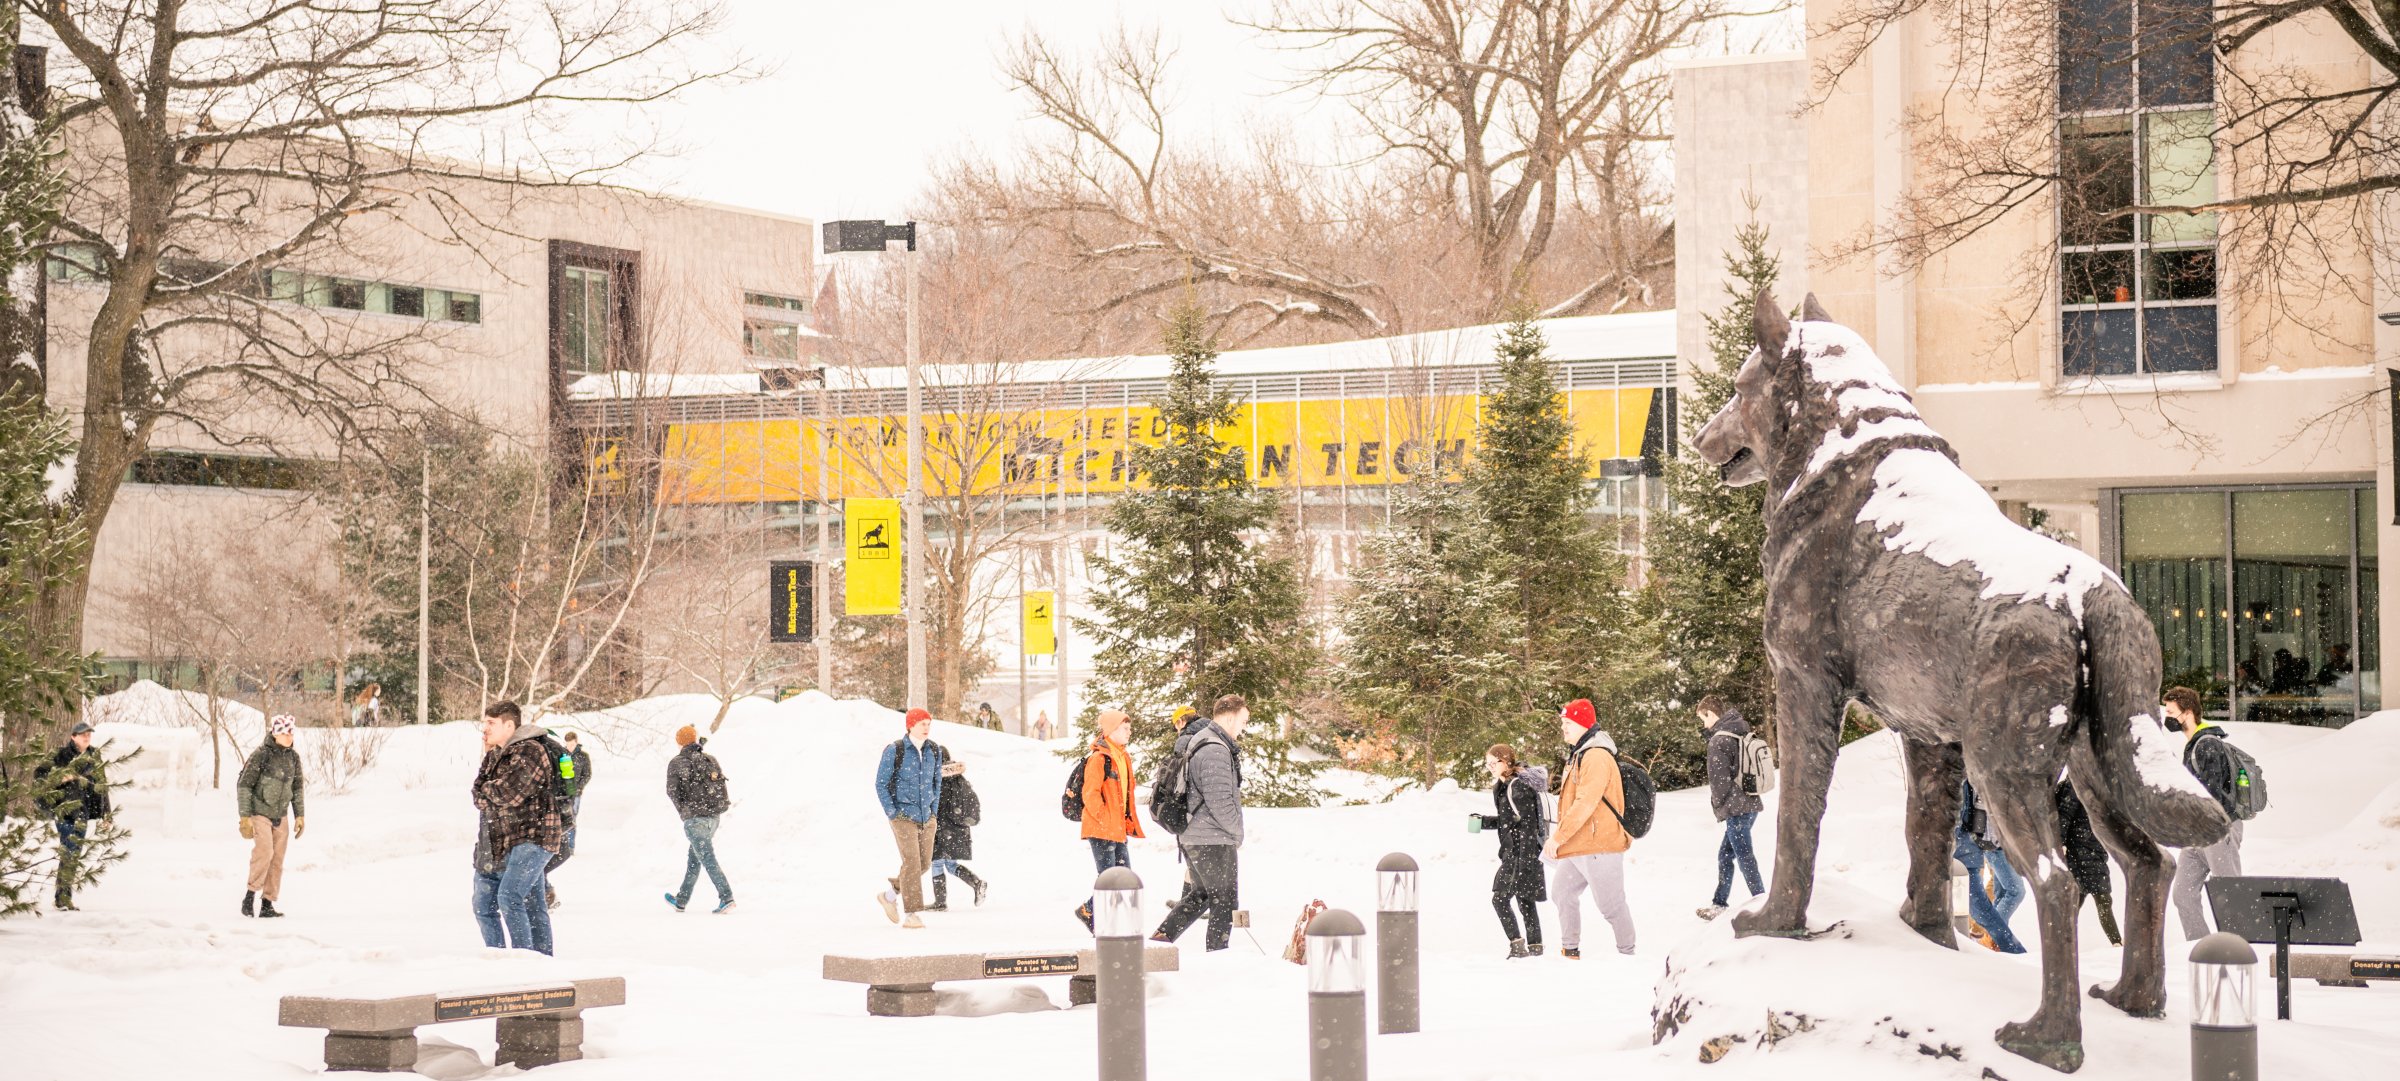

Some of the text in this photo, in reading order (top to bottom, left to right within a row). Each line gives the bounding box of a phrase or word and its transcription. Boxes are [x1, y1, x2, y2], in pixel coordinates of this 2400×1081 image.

[1073, 415, 1184, 440] NEED
[1320, 438, 1465, 476] TECH
[788, 569, 798, 634] Michigan Tech
